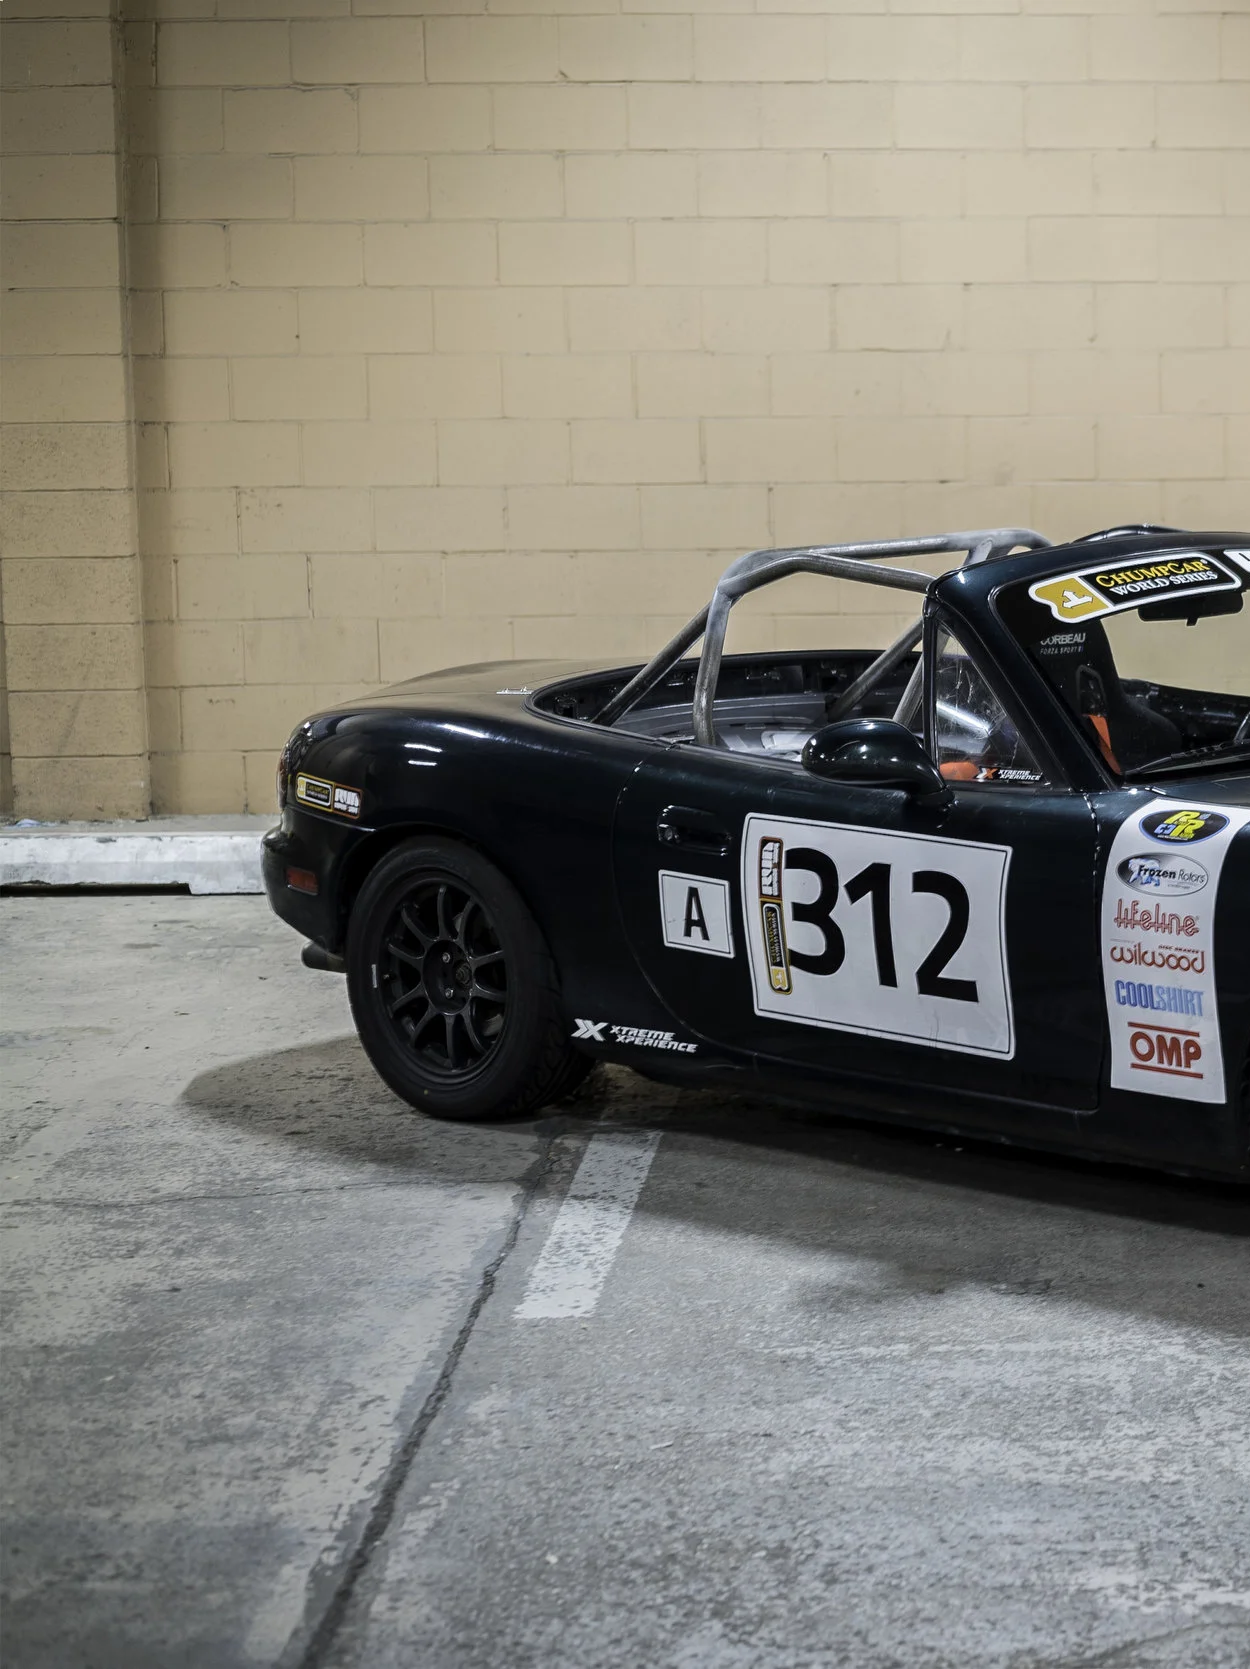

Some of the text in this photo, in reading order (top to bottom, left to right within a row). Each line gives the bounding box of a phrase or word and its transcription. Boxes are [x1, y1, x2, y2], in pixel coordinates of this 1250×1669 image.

[1109, 570, 1218, 596] WORLD SERIES
[1138, 864, 1206, 883] Frozen Rotors
[683, 886, 710, 941] A
[784, 847, 980, 1003] 312
[1114, 898, 1199, 937] lifeline
[1110, 942, 1205, 974] wilwood
[1115, 979, 1205, 1017] COOLSHIRT
[610, 1025, 676, 1042] XTREME
[615, 1034, 699, 1053] XPERIENCE
[1129, 1031, 1202, 1069] OMP
